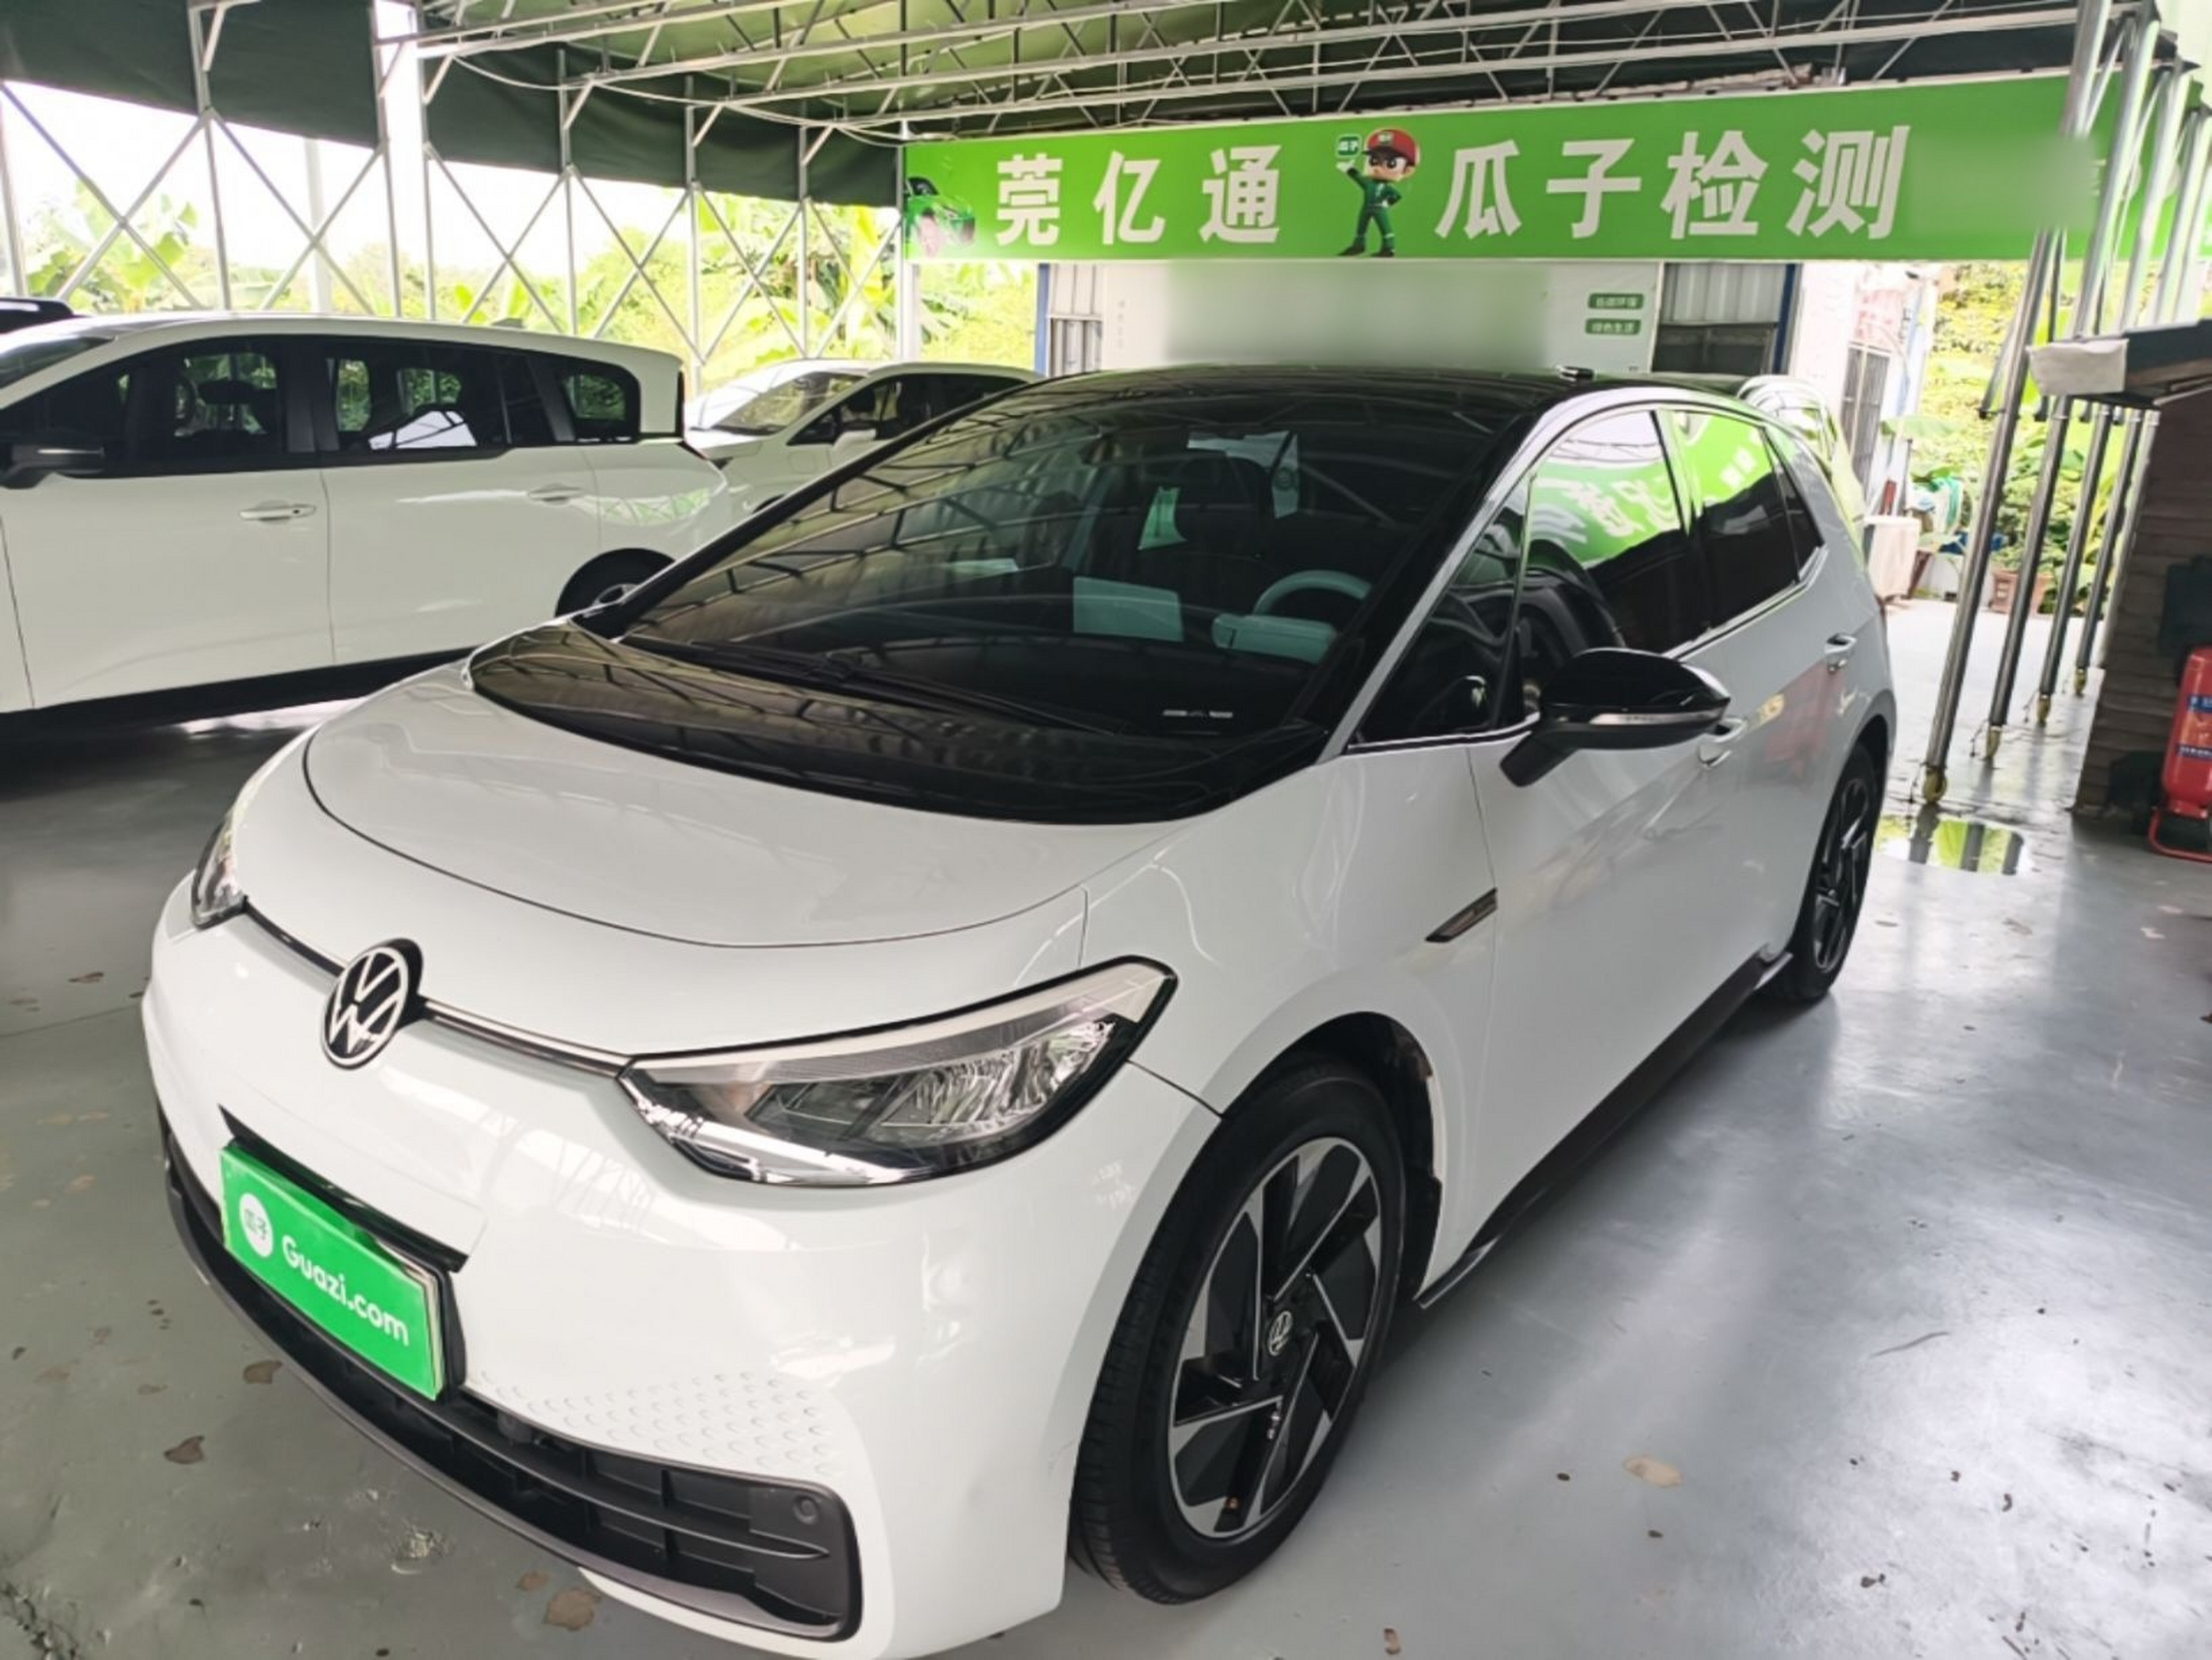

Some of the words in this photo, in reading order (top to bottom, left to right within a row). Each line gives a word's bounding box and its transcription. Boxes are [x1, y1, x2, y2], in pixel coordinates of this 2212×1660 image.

[995, 145, 1281, 246] 莞亿通
[1435, 125, 1911, 240] 瓜子检测
[282, 1235, 410, 1347] Guazi.com
